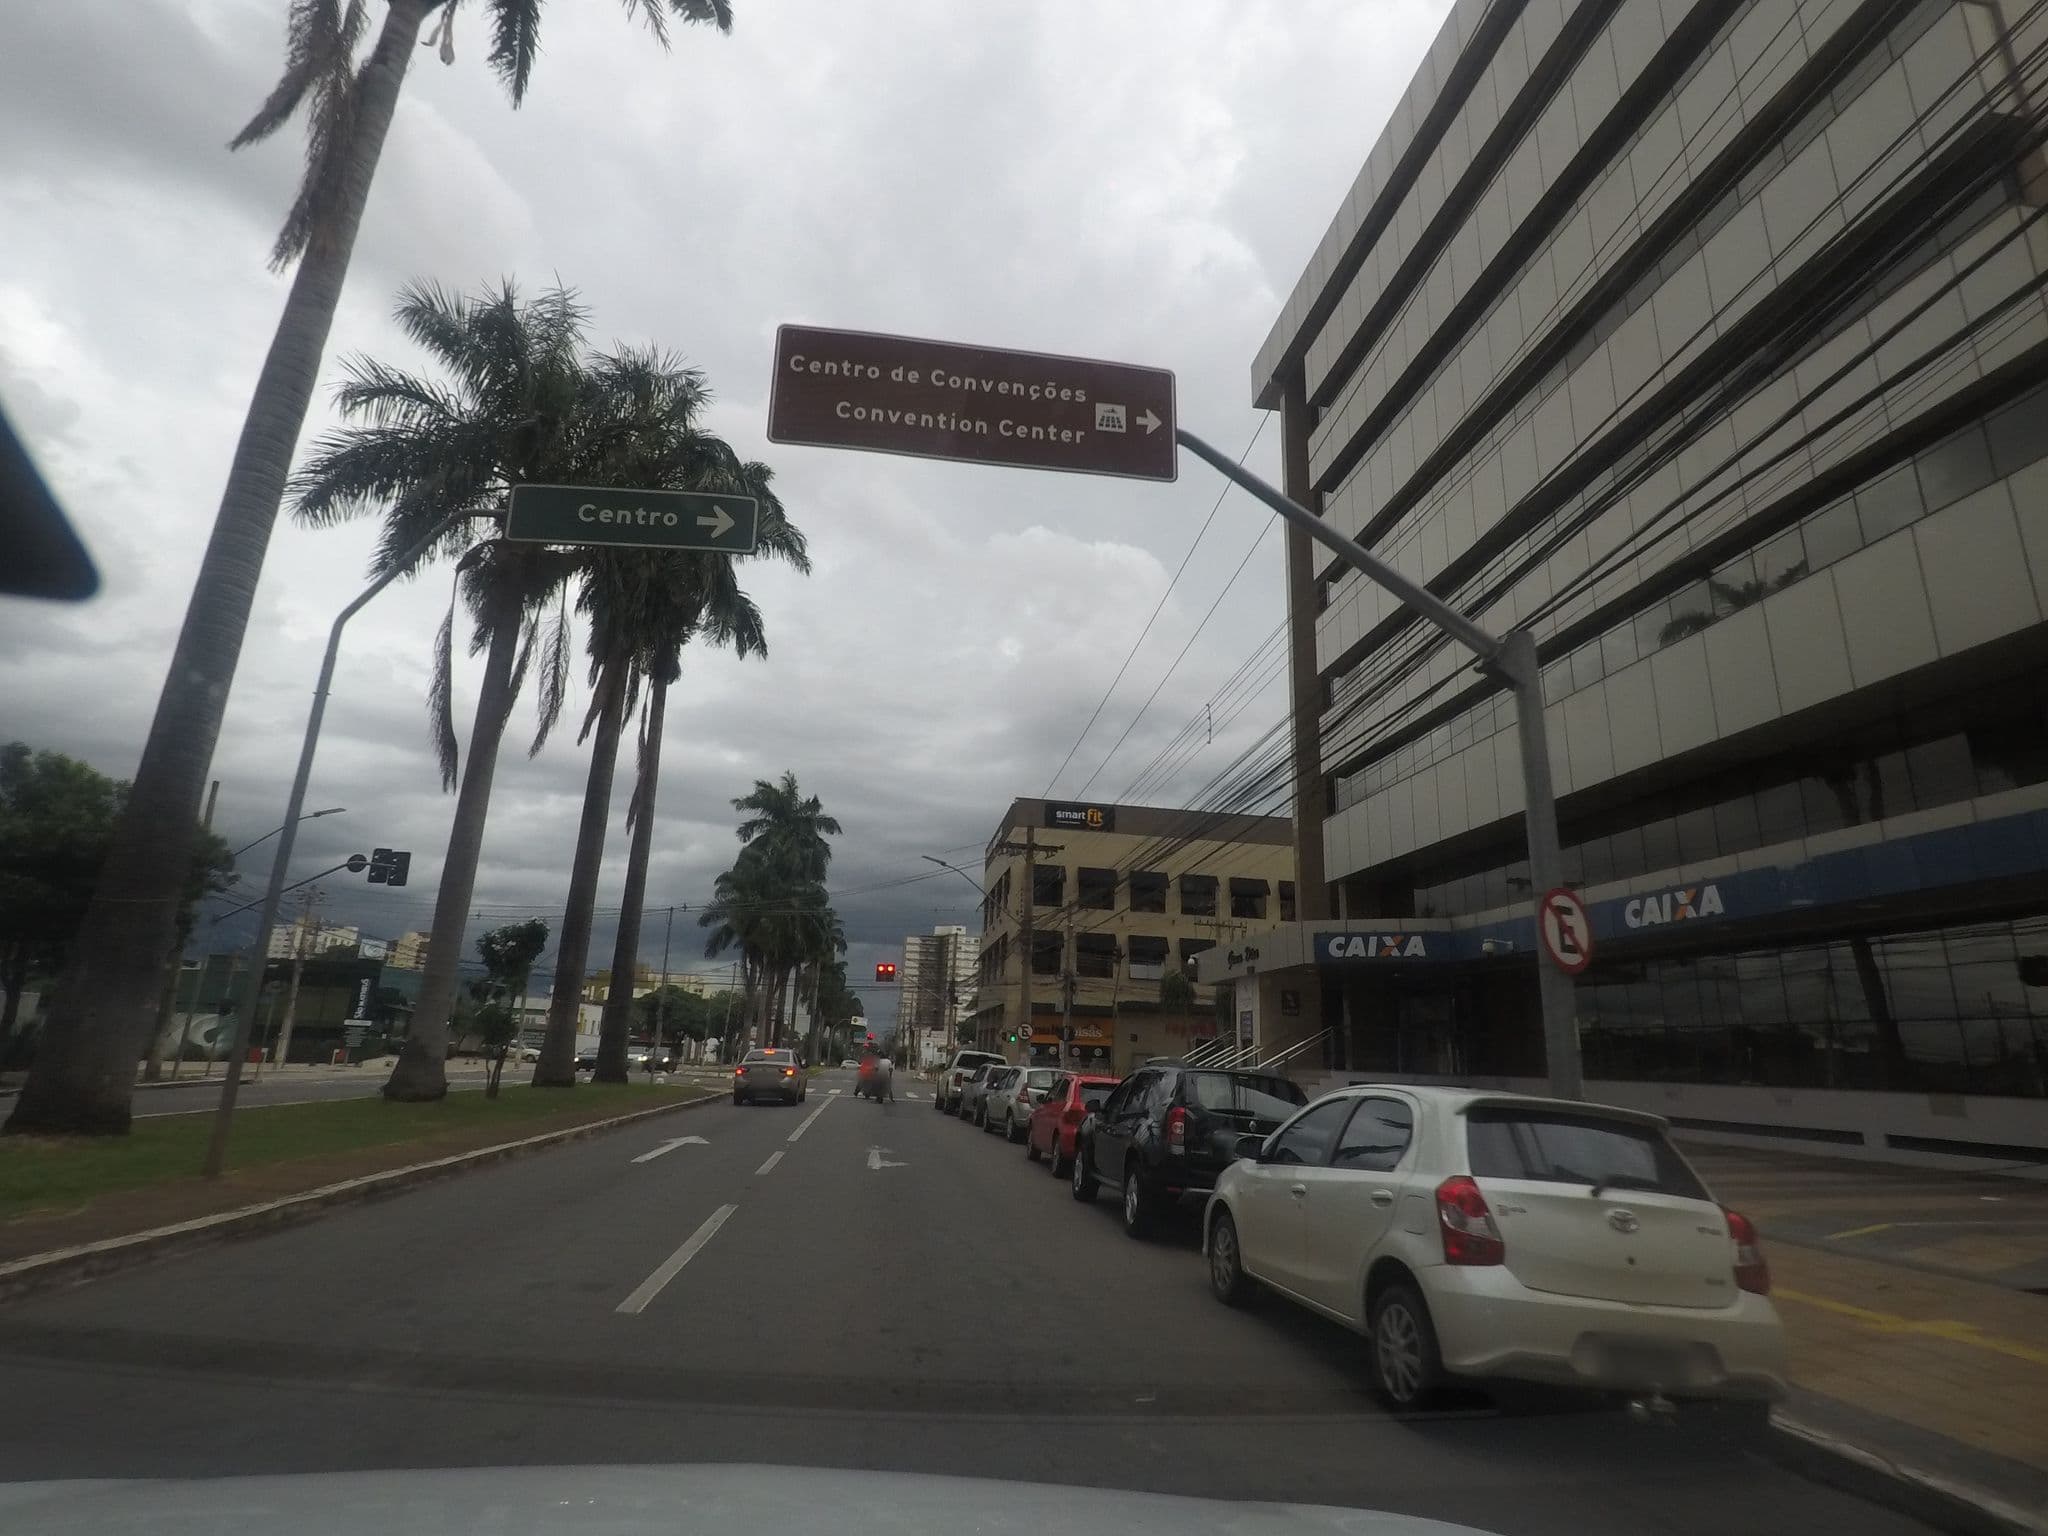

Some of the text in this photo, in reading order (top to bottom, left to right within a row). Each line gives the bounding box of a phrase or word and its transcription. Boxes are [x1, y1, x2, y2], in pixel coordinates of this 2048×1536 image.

[789, 355, 1087, 402] Centro de Convenções
[836, 402, 1086, 444] Convention Center
[578, 503, 678, 526] Centro
[1056, 810, 1086, 820] smart
[1087, 808, 1104, 825] fit
[1624, 884, 1724, 929] CAIXA
[1328, 935, 1426, 958] CAIXA
